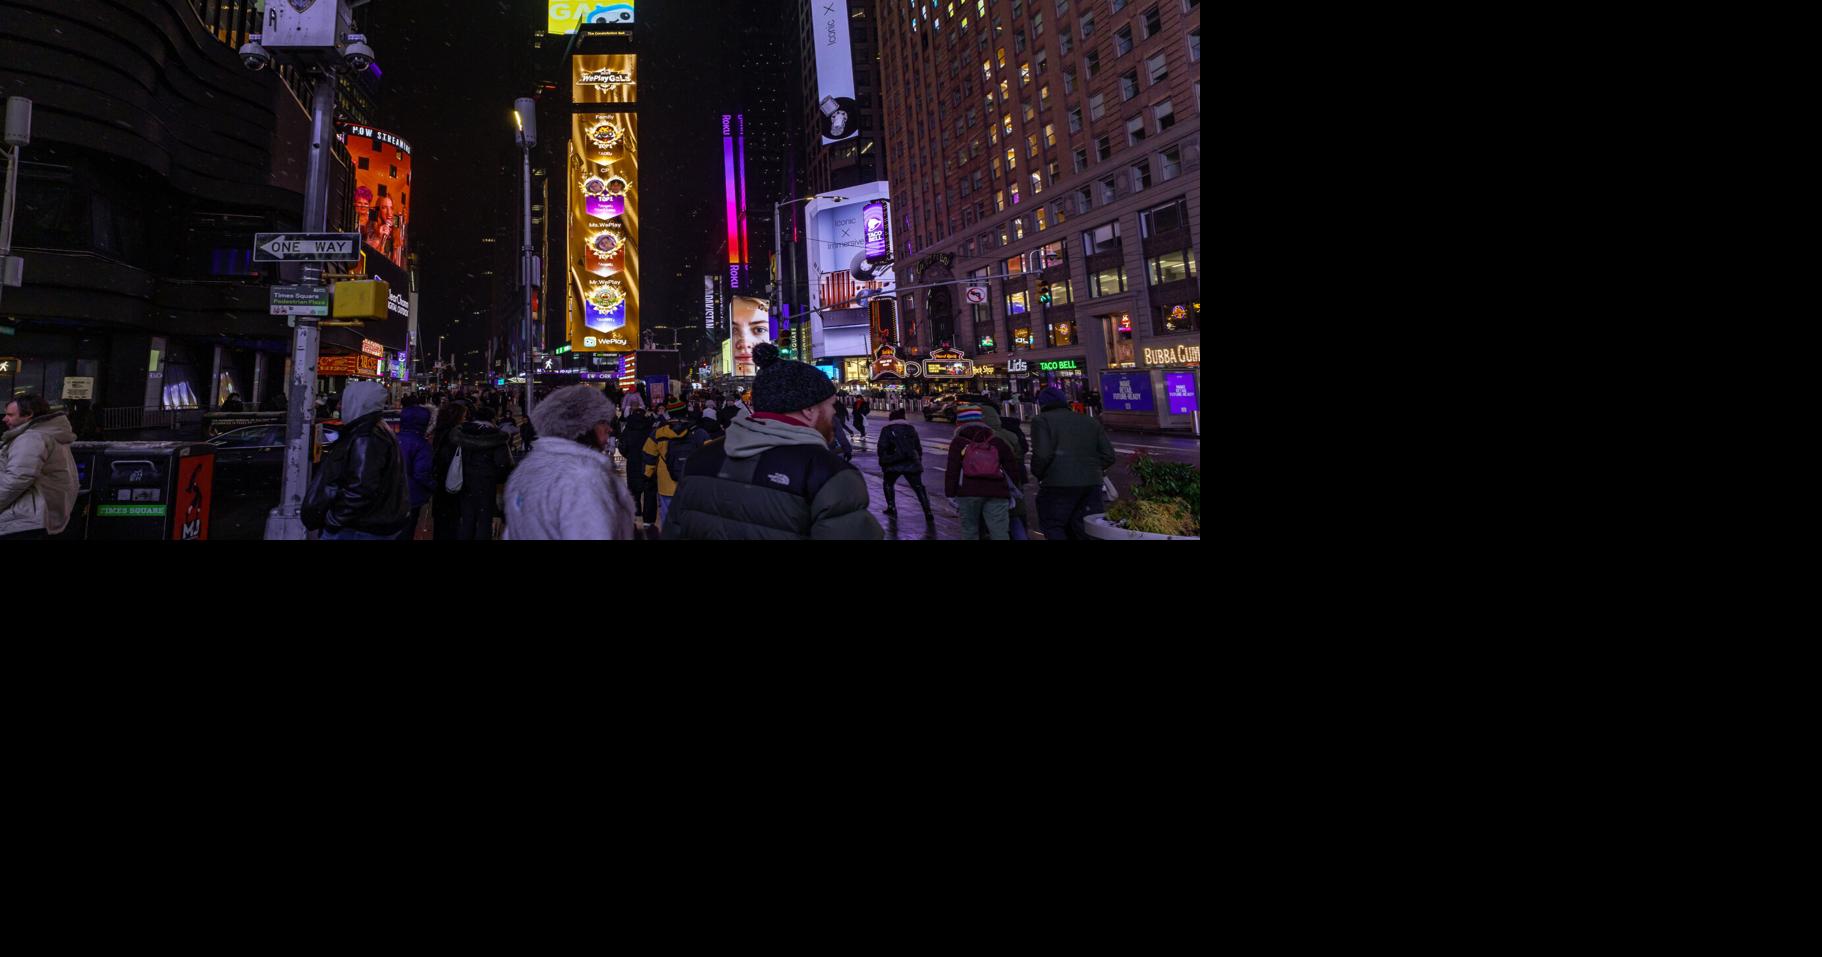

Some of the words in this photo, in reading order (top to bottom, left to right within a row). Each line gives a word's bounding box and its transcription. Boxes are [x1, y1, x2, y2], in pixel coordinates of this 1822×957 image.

[377, 132, 411, 154] STREAMING
[271, 242, 300, 253] ONE
[315, 242, 346, 253] WAY
[1144, 347, 1177, 365] BUBBA
[1007, 359, 1028, 373] Lids
[1040, 362, 1058, 371] TACO
[1058, 360, 1077, 370] BELL
[130, 506, 164, 514] SQUARE
[183, 520, 200, 539] MJ
